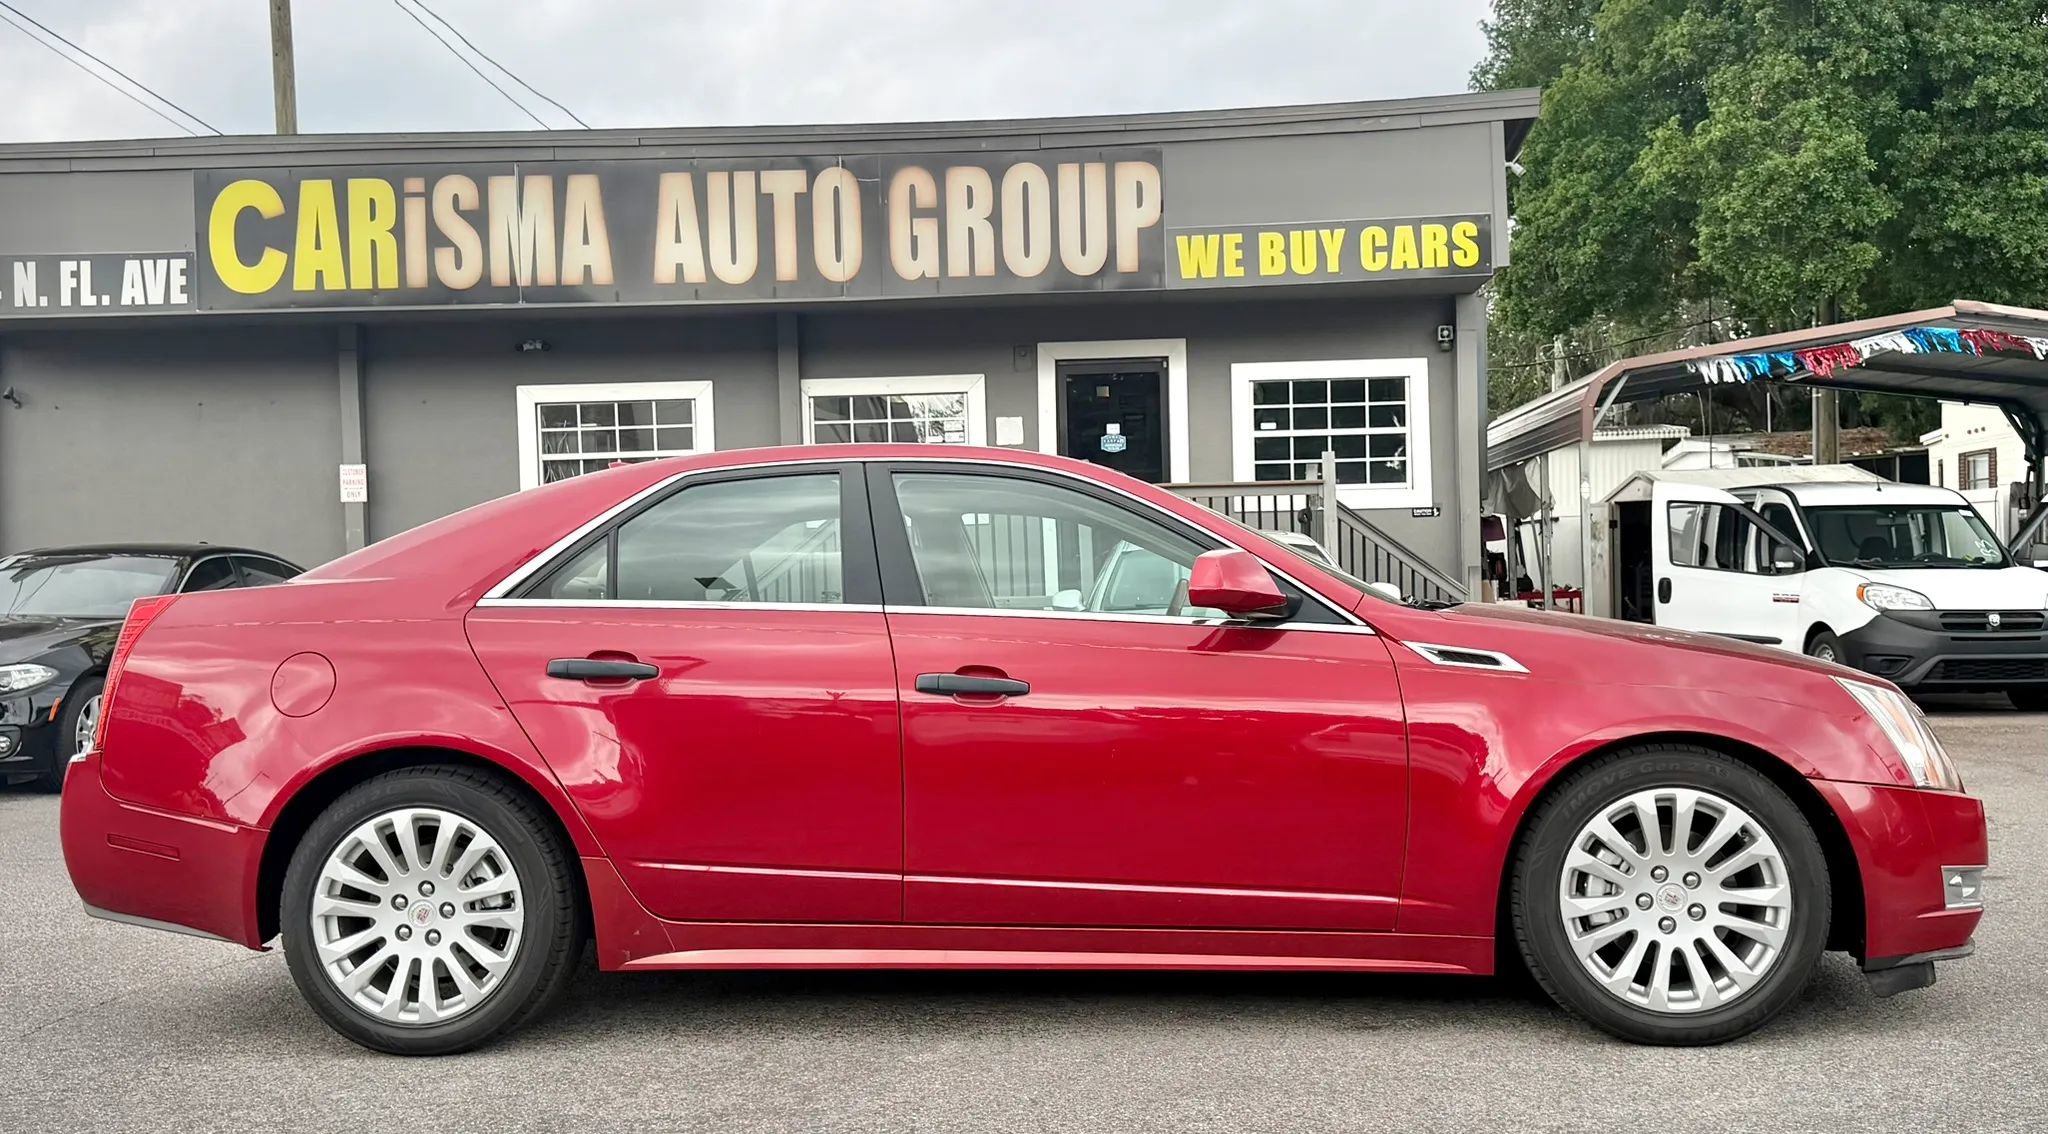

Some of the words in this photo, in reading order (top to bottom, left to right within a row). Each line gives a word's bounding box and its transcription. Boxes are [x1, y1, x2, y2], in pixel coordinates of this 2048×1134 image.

[653, 165, 863, 285] AUTO
[888, 160, 1162, 281] GROUP
[1175, 232, 1245, 280] WE
[1258, 228, 1346, 276] BUY
[1360, 221, 1480, 272] CARS
[13, 261, 48, 307] N.
[60, 260, 110, 306] FL.
[120, 258, 188, 305] AVE
